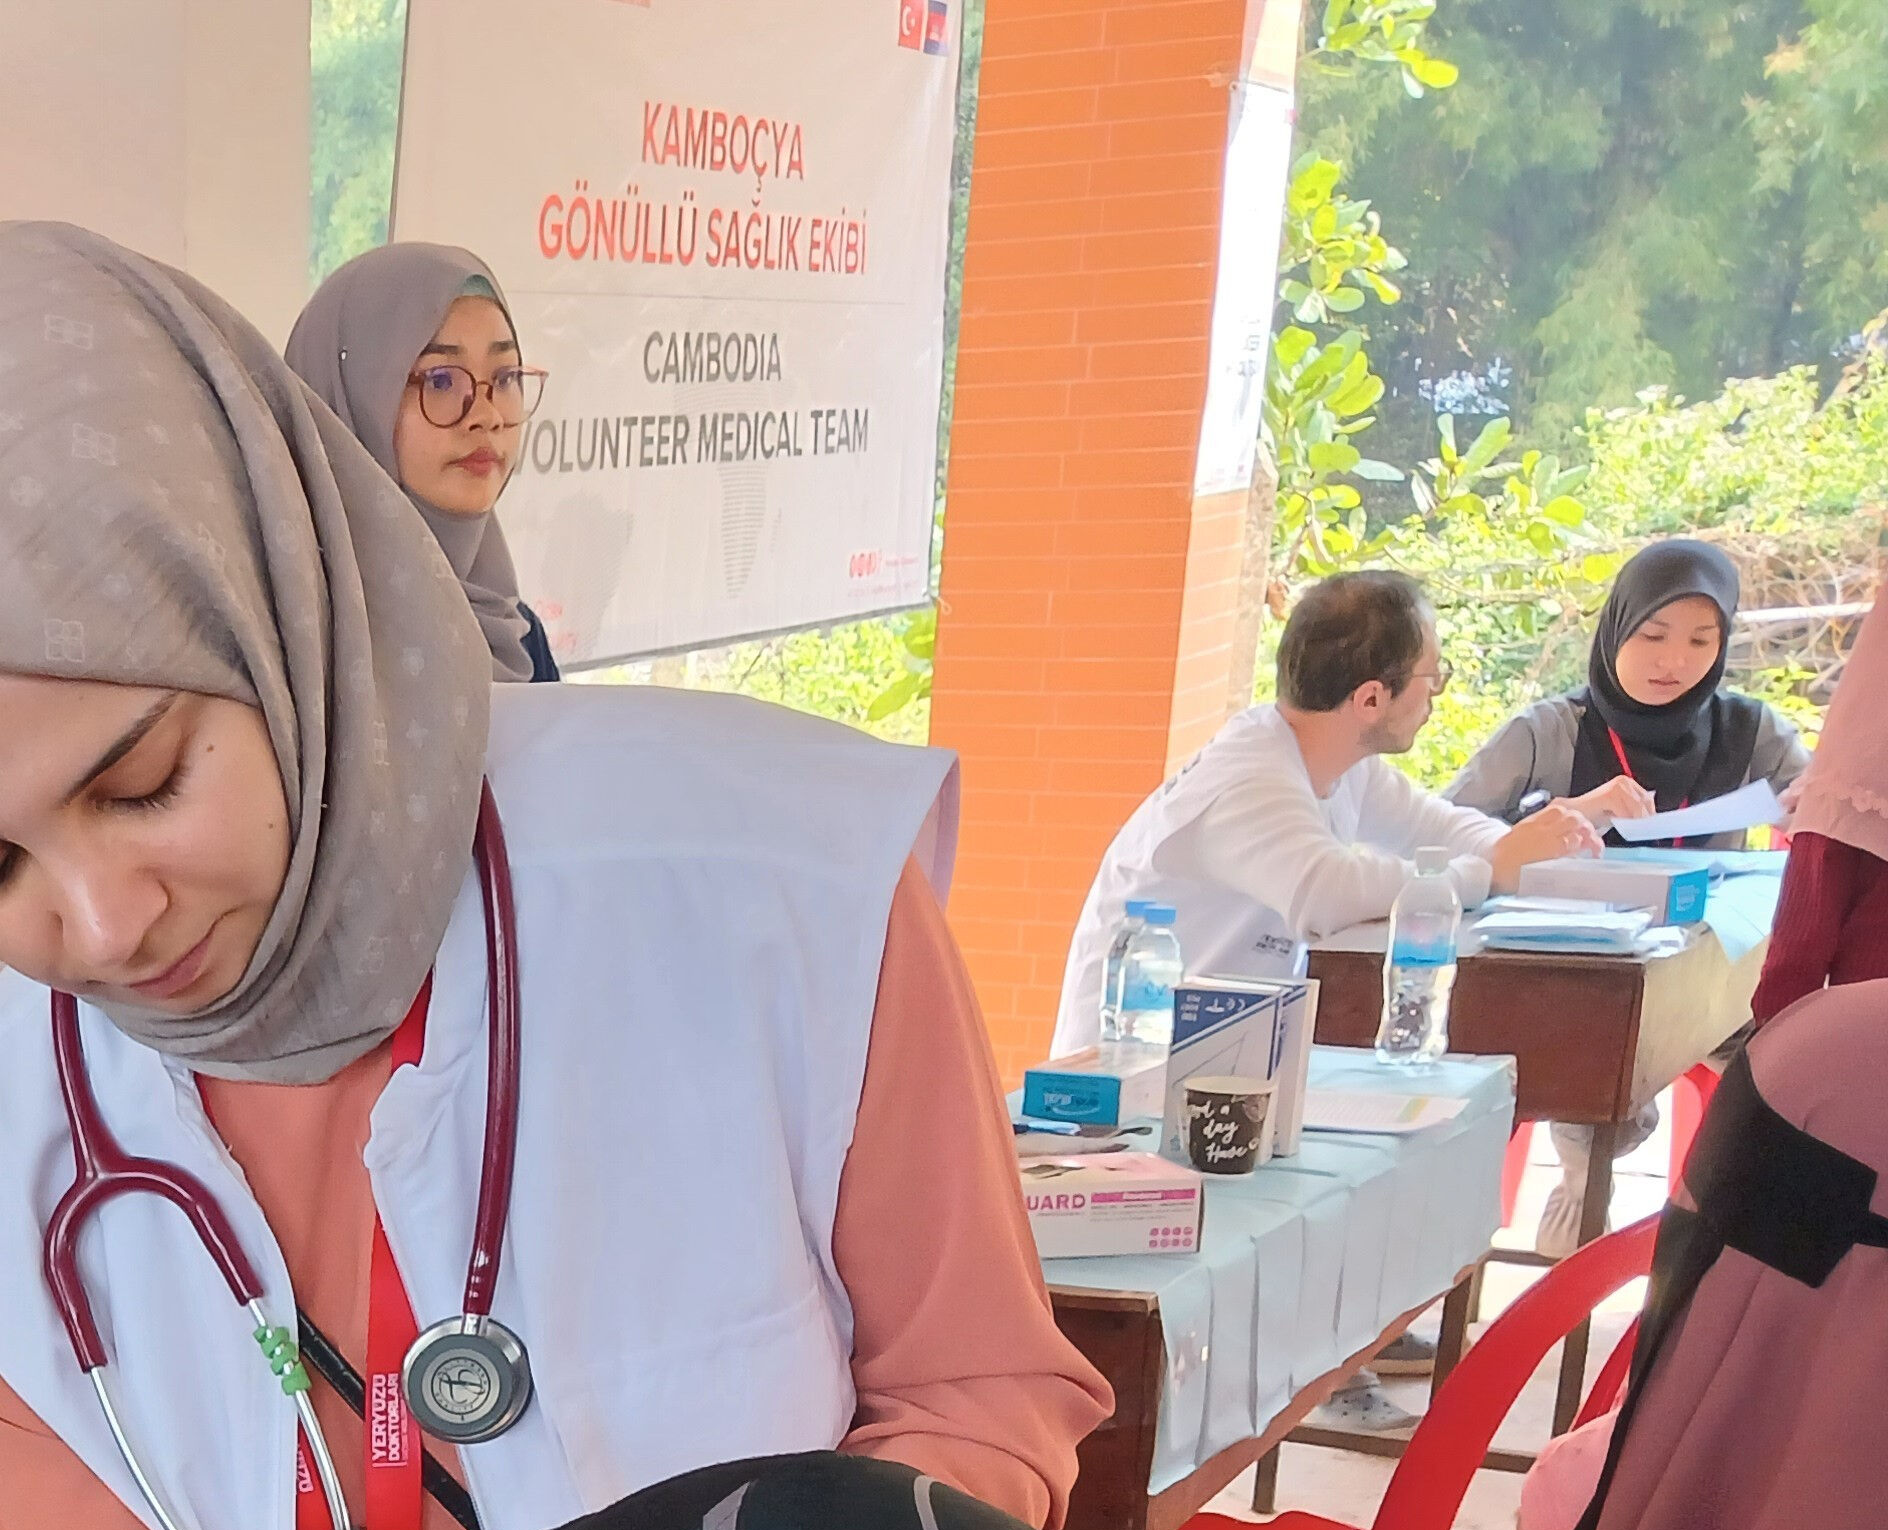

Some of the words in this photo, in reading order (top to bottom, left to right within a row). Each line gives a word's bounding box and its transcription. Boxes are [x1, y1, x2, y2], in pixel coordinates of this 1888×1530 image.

[642, 101, 804, 192] KAMBOÇYA
[538, 179, 698, 267] GÖNÜLLÜ
[706, 199, 802, 272] SAĞLIK
[808, 206, 867, 275] EKİBİ
[643, 331, 782, 384] CAMBODIA
[697, 410, 803, 464] MEDICAL
[811, 408, 869, 457] TEAM
[387, 1372, 400, 1462] DOKTORLARI
